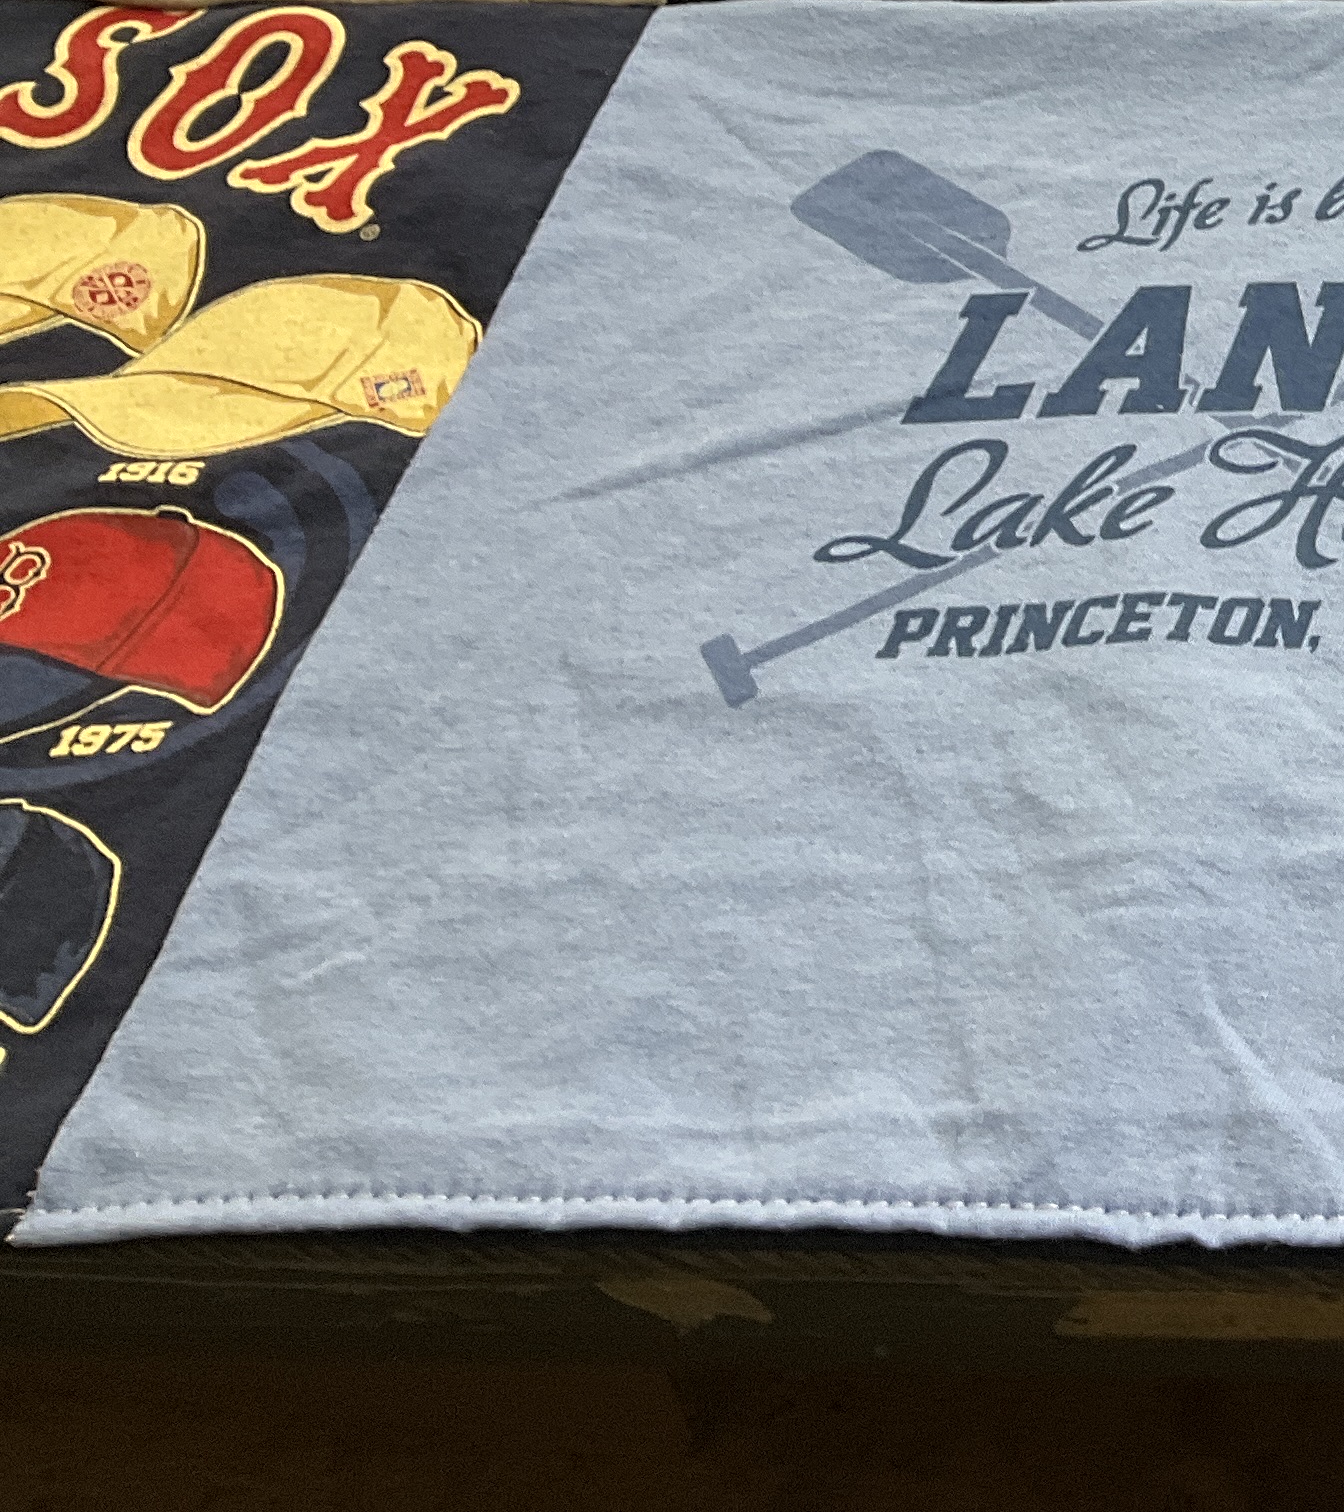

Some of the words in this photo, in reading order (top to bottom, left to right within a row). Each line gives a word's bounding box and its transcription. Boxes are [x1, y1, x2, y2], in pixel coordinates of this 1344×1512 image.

[0, 5, 521, 234] SOX
[1076, 176, 1234, 254] Life
[1247, 179, 1304, 228] is
[98, 460, 206, 486] 1916
[812, 437, 1177, 567] Lake
[874, 590, 1322, 660] PRINCETON,
[48, 720, 174, 758] 1975
